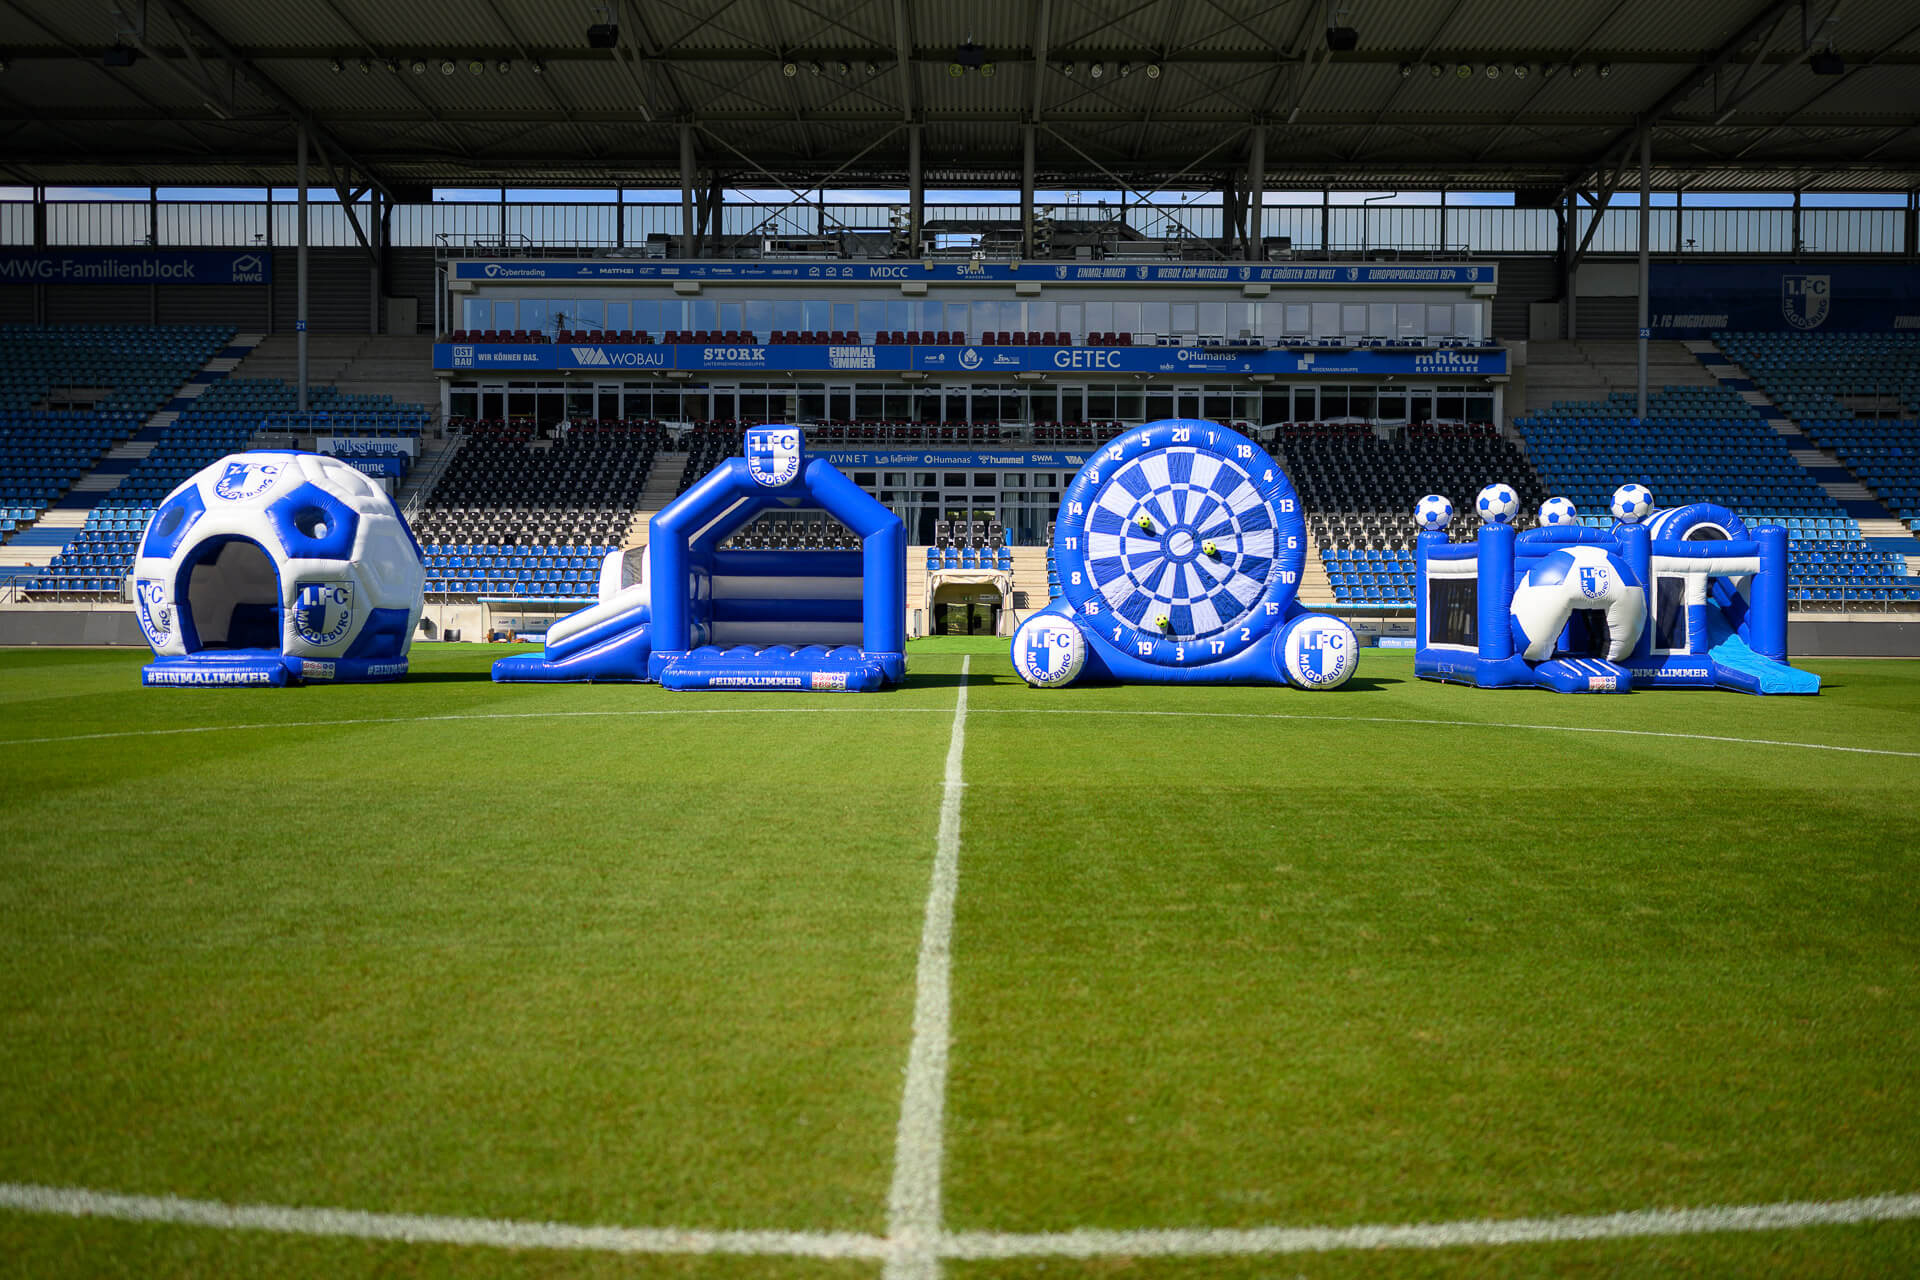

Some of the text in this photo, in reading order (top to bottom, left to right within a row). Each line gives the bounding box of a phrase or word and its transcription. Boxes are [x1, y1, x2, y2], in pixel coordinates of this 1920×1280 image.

[0, 258, 195, 279] MWG-Familienblock
[500, 268, 545, 277] Cybertrading
[869, 266, 908, 278] MDCC
[233, 273, 263, 282] MWG
[478, 352, 539, 361] WIR KÖNNEN DAS.
[704, 348, 765, 360] STORK
[829, 346, 876, 357] EINMAL
[1189, 351, 1237, 361] Humanas
[455, 357, 473, 366] BAU
[609, 353, 664, 366] WOBAU
[1054, 350, 1120, 368] GETEC
[1416, 352, 1479, 365] mhkw
[1141, 432, 1150, 447] 5
[1172, 428, 1189, 441] 20
[1207, 431, 1215, 445] 1
[333, 439, 399, 451] Volksstimme
[752, 435, 795, 452] 1.FC
[1109, 447, 1123, 460] 12
[1236, 444, 1252, 458] 18
[829, 454, 868, 464] AVNET
[933, 456, 970, 464] Humanas
[990, 455, 1024, 464] hummel
[1031, 454, 1053, 462] SWM
[750, 456, 797, 484] MAGDEBURG
[1263, 469, 1274, 482] 4
[1090, 471, 1099, 484] 9
[1067, 502, 1083, 515] 14
[1279, 500, 1294, 512] 13
[1065, 537, 1077, 550] 11
[1287, 536, 1297, 548] 6
[1071, 572, 1081, 585] 8
[1280, 571, 1296, 584] 10
[300, 587, 349, 606] 1.FC
[1084, 602, 1099, 615] 16
[1265, 602, 1279, 615] 15
[297, 610, 349, 642] MAGDEBURG
[1029, 632, 1070, 648] 1.FC
[1113, 627, 1122, 641] 7
[1241, 628, 1250, 641] 2
[1210, 641, 1225, 654] 17
[1301, 633, 1343, 650] 1.FC
[1138, 642, 1153, 655] 19
[1175, 648, 1184, 661] 3
[1027, 652, 1071, 681] MAGDEBURG
[1300, 654, 1345, 683] MAGDEBURG
[147, 672, 270, 683] #EINMALIMMER
[708, 677, 801, 686] #EINMALIMMER
